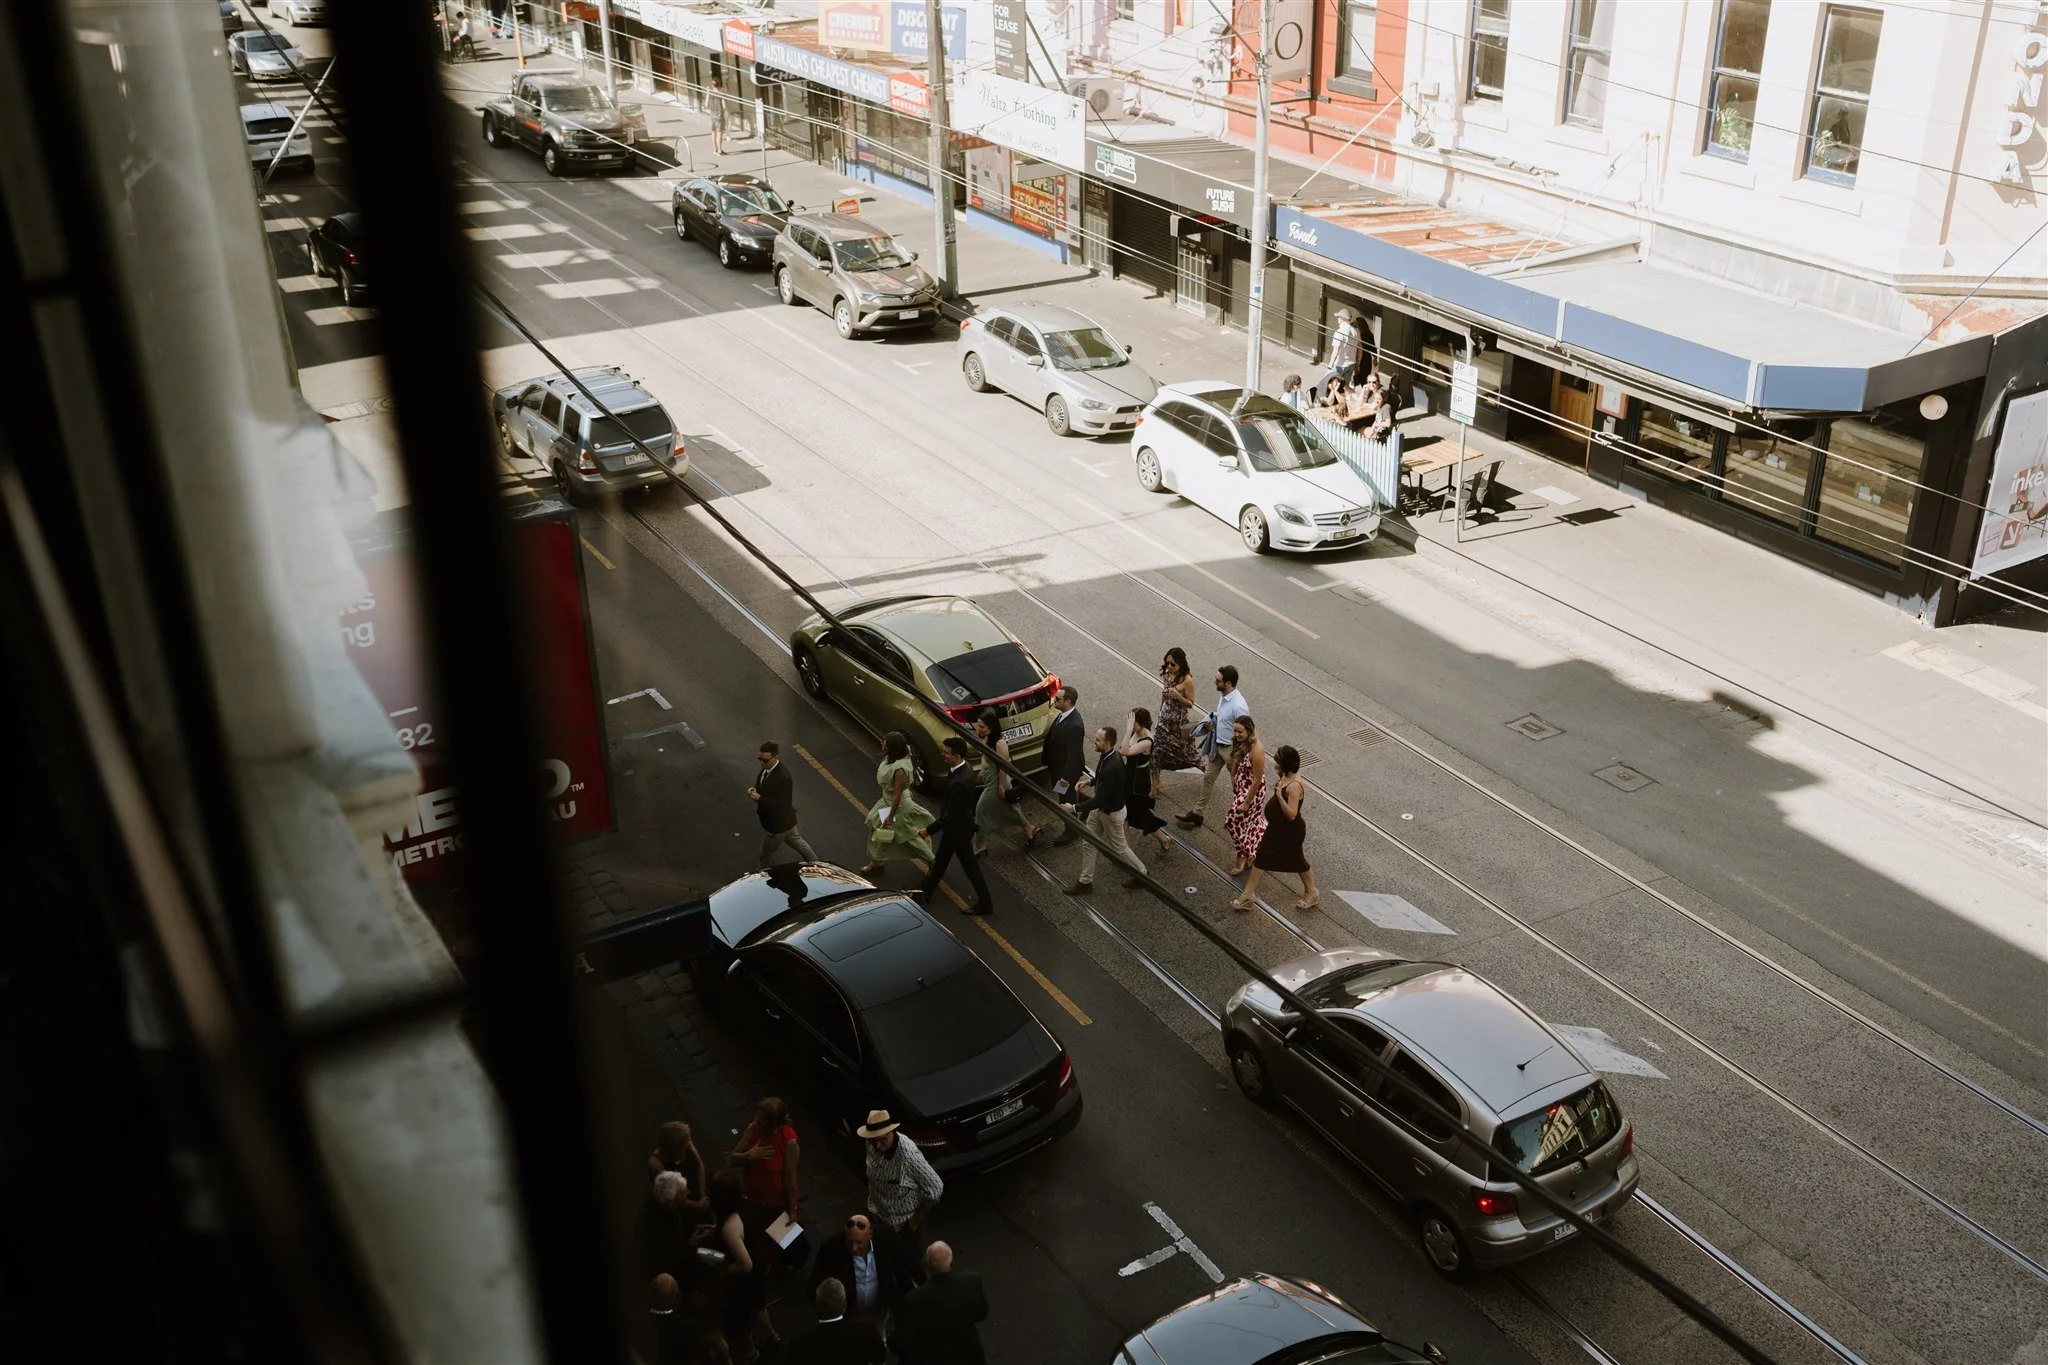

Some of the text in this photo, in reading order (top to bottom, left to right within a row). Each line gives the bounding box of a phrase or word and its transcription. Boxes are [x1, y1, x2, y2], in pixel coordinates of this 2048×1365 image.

[897, 9, 959, 31] DISCNT
[994, 4, 1010, 18] FOR
[828, 12, 881, 32] CHEMIST
[994, 18, 1019, 34] LEASE
[725, 26, 753, 48] CHEMIST
[828, 29, 881, 41] WAREHOUSE
[901, 30, 954, 51] CHET
[763, 42, 809, 74] AUSTRALIA'S
[810, 57, 849, 85] CHEAPEST
[851, 69, 888, 100] CHEMIST
[890, 78, 927, 105] CHEMIST
[1205, 188, 1235, 201] FUTURE
[1211, 200, 1235, 213] SUSHI
[1289, 221, 1318, 247] Fonda
